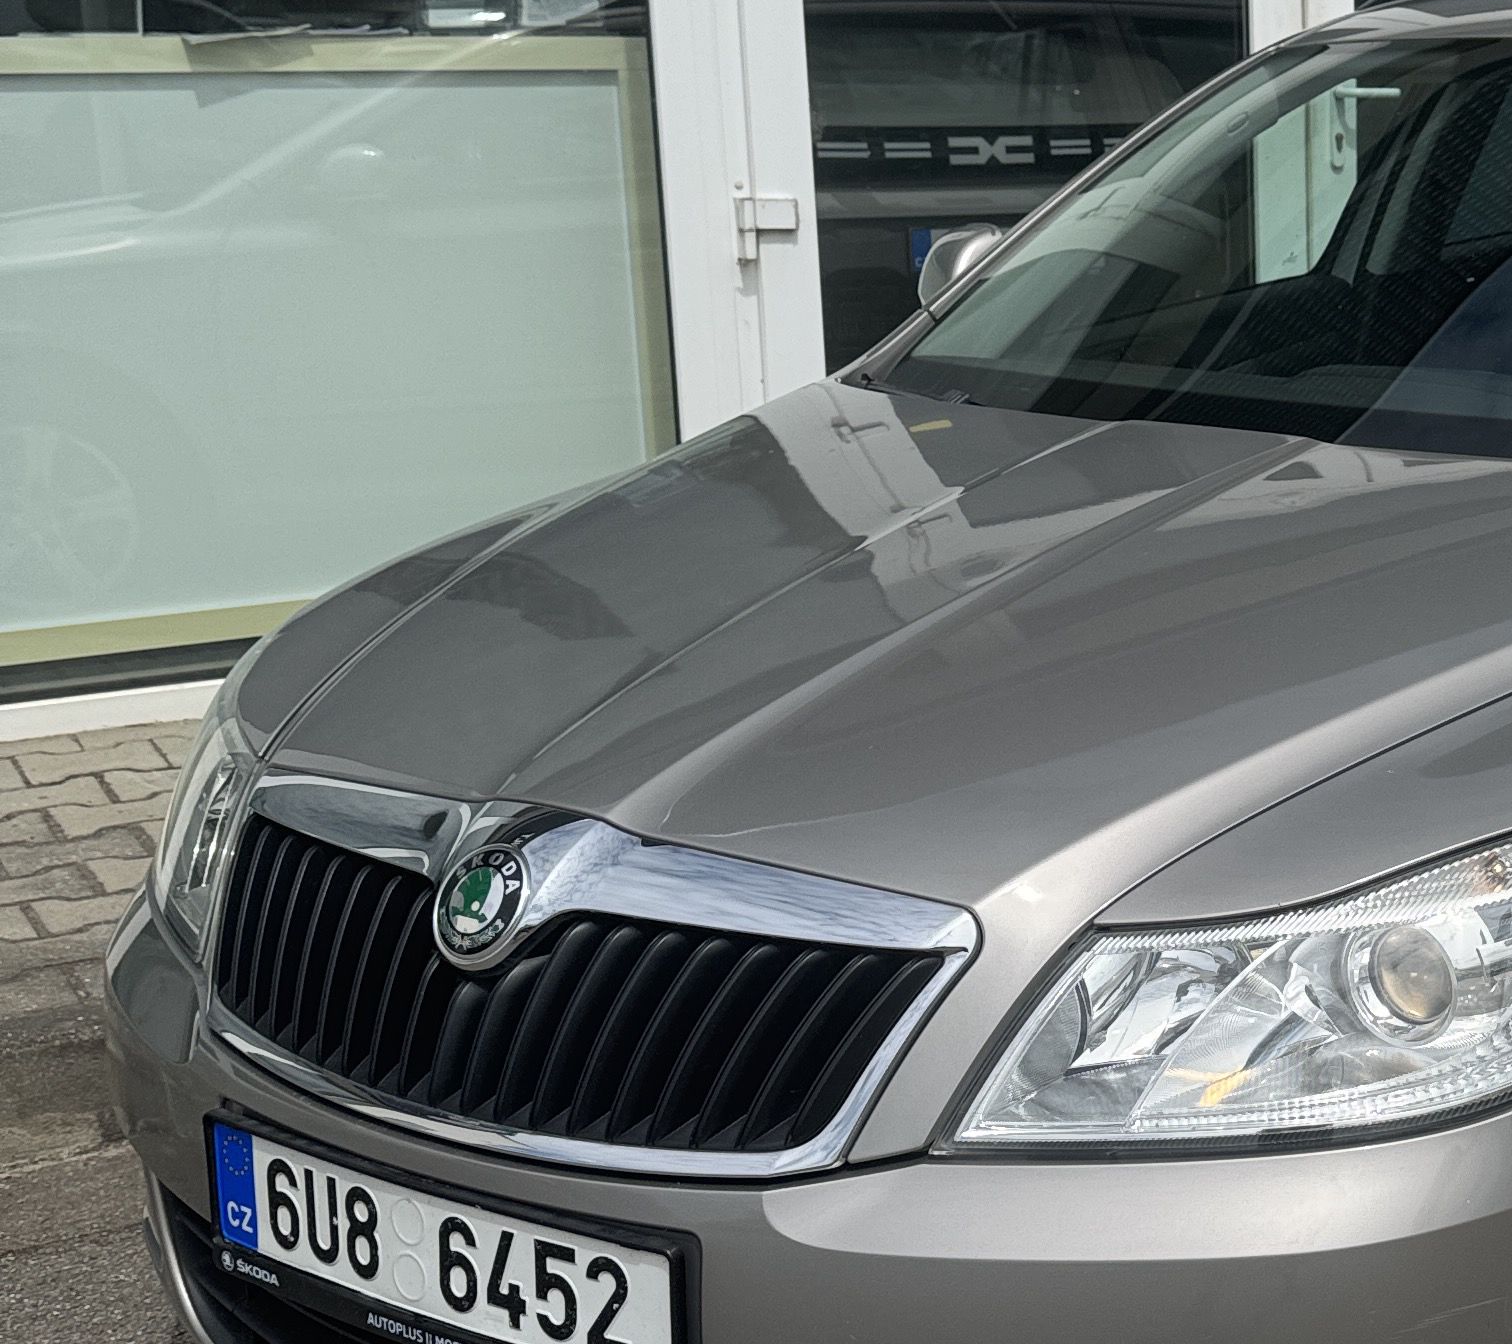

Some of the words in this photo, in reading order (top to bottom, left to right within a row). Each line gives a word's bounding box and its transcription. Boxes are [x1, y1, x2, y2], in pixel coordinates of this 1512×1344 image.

[227, 1201, 254, 1233] CZ
[266, 1158, 380, 1281] 6U8
[236, 1258, 280, 1288] ŠKODA
[367, 1312, 424, 1343] AUTOPLUS
